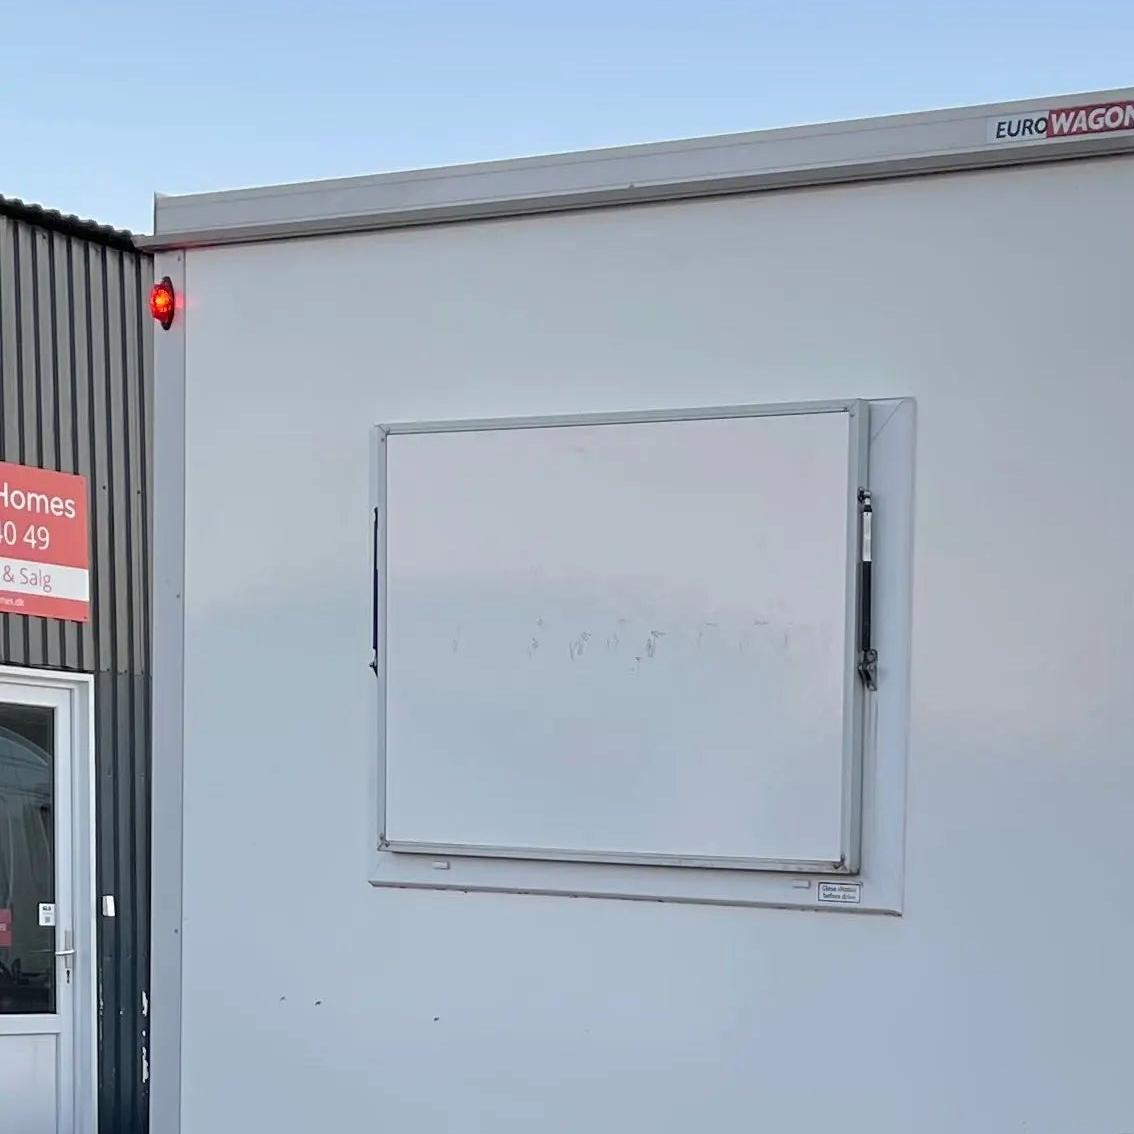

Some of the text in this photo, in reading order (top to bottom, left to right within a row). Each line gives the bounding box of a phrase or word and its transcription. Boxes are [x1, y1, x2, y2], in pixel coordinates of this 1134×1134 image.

[0, 521, 50, 550] 0 49
[3, 565, 52, 593] & Salg
